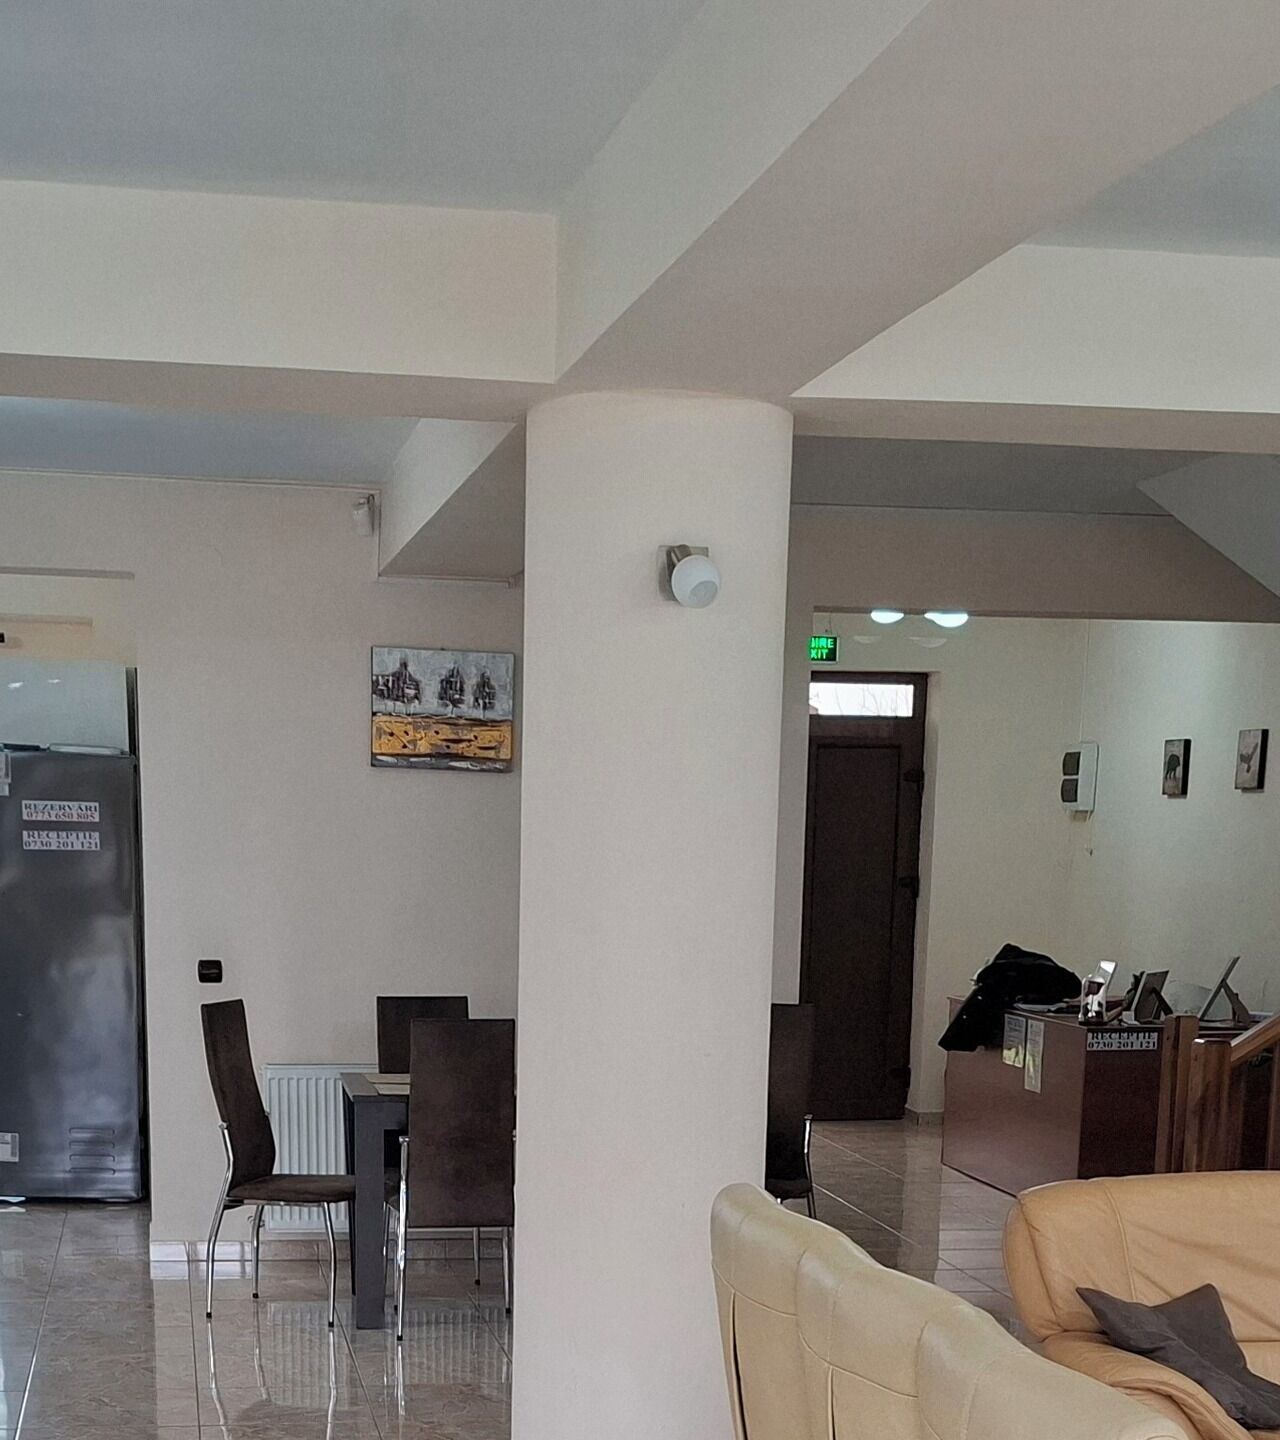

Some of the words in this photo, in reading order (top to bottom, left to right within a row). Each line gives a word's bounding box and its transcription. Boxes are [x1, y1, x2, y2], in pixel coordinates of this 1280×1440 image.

[55, 812, 74, 821] 650
[24, 840, 52, 849] 0730
[56, 840, 75, 849] 201
[81, 841, 99, 850] 121
[1088, 1041, 1114, 1049] 0730
[1117, 1041, 1134, 1049] 201
[1139, 1041, 1156, 1049] 121
